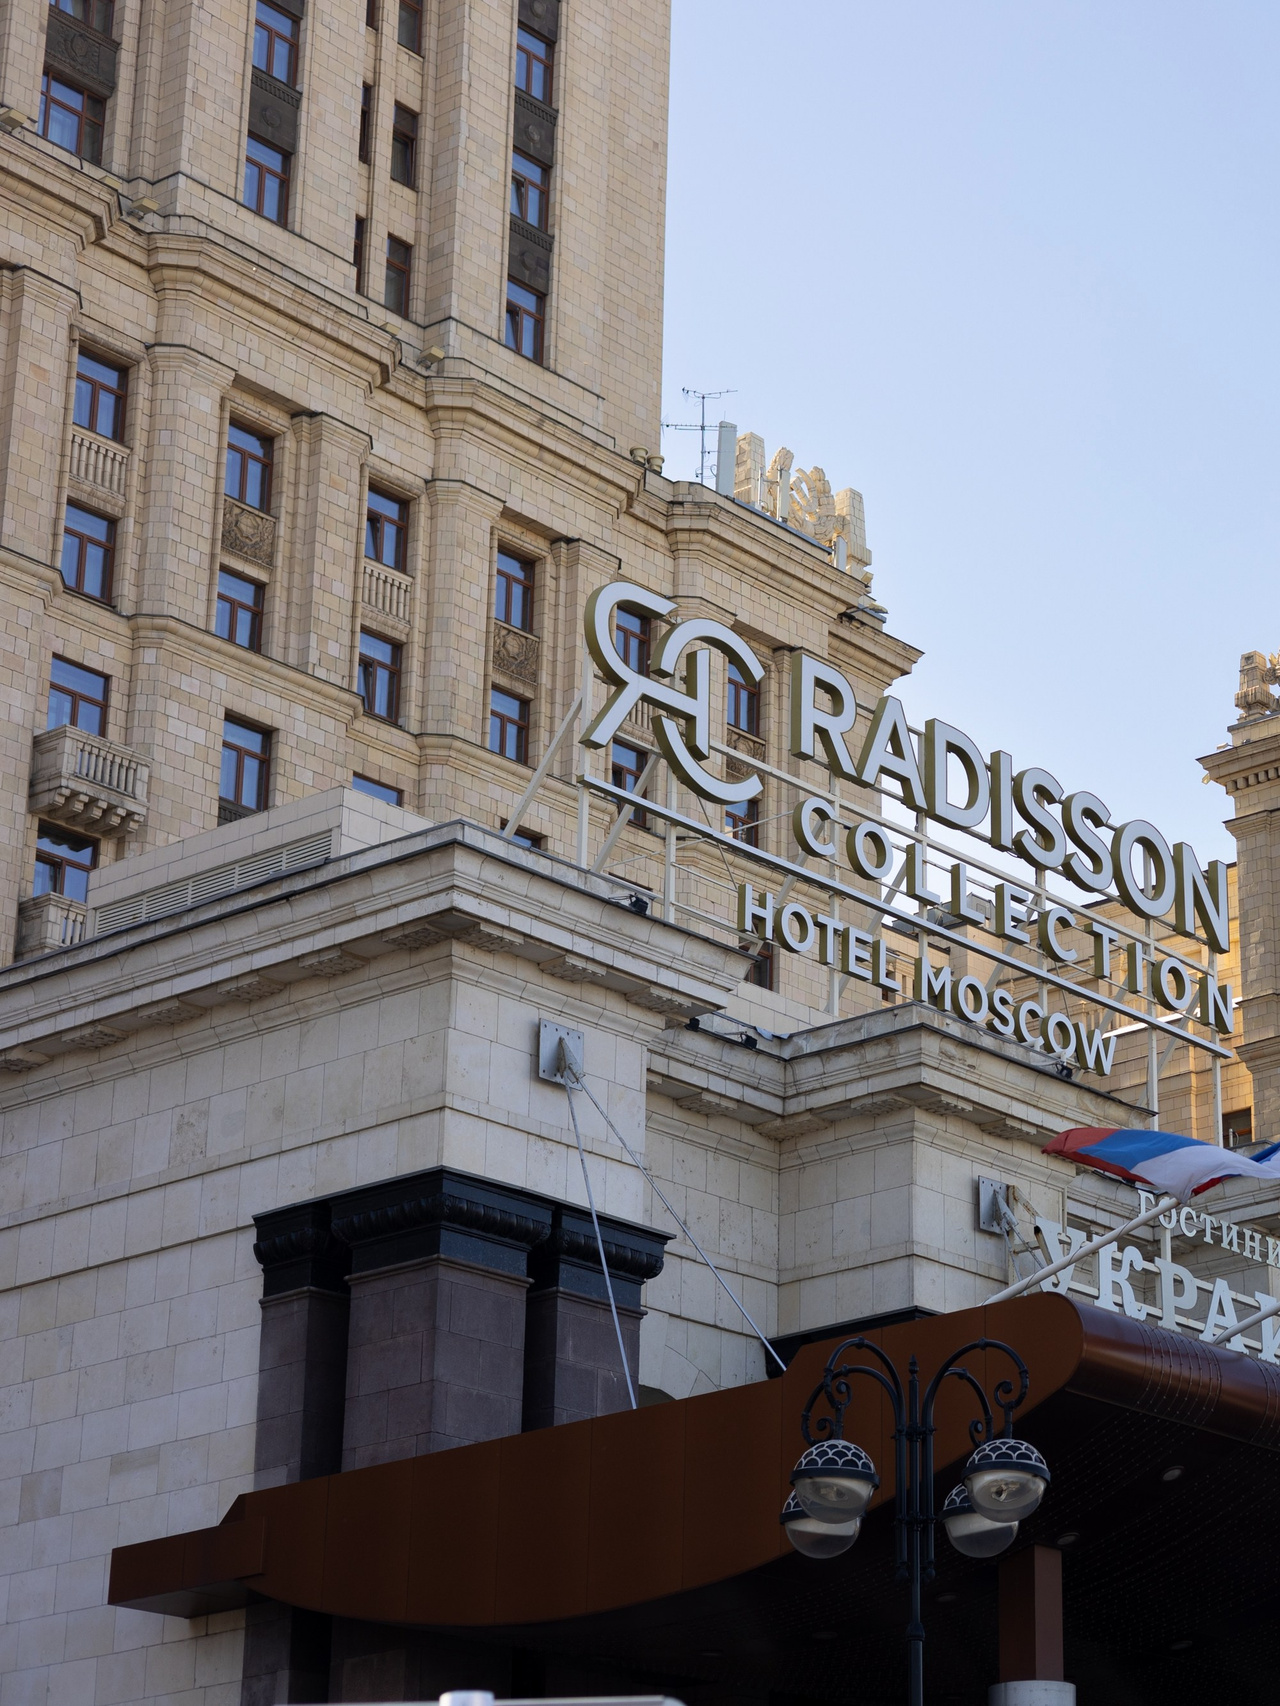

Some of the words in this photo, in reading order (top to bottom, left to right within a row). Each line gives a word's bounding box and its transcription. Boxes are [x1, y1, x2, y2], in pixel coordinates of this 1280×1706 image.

[791, 651, 1229, 953] RADISSON
[793, 798, 1234, 1035] COLLECTION
[737, 883, 900, 993] HOTEL
[914, 956, 1118, 1076] MOSCOW
